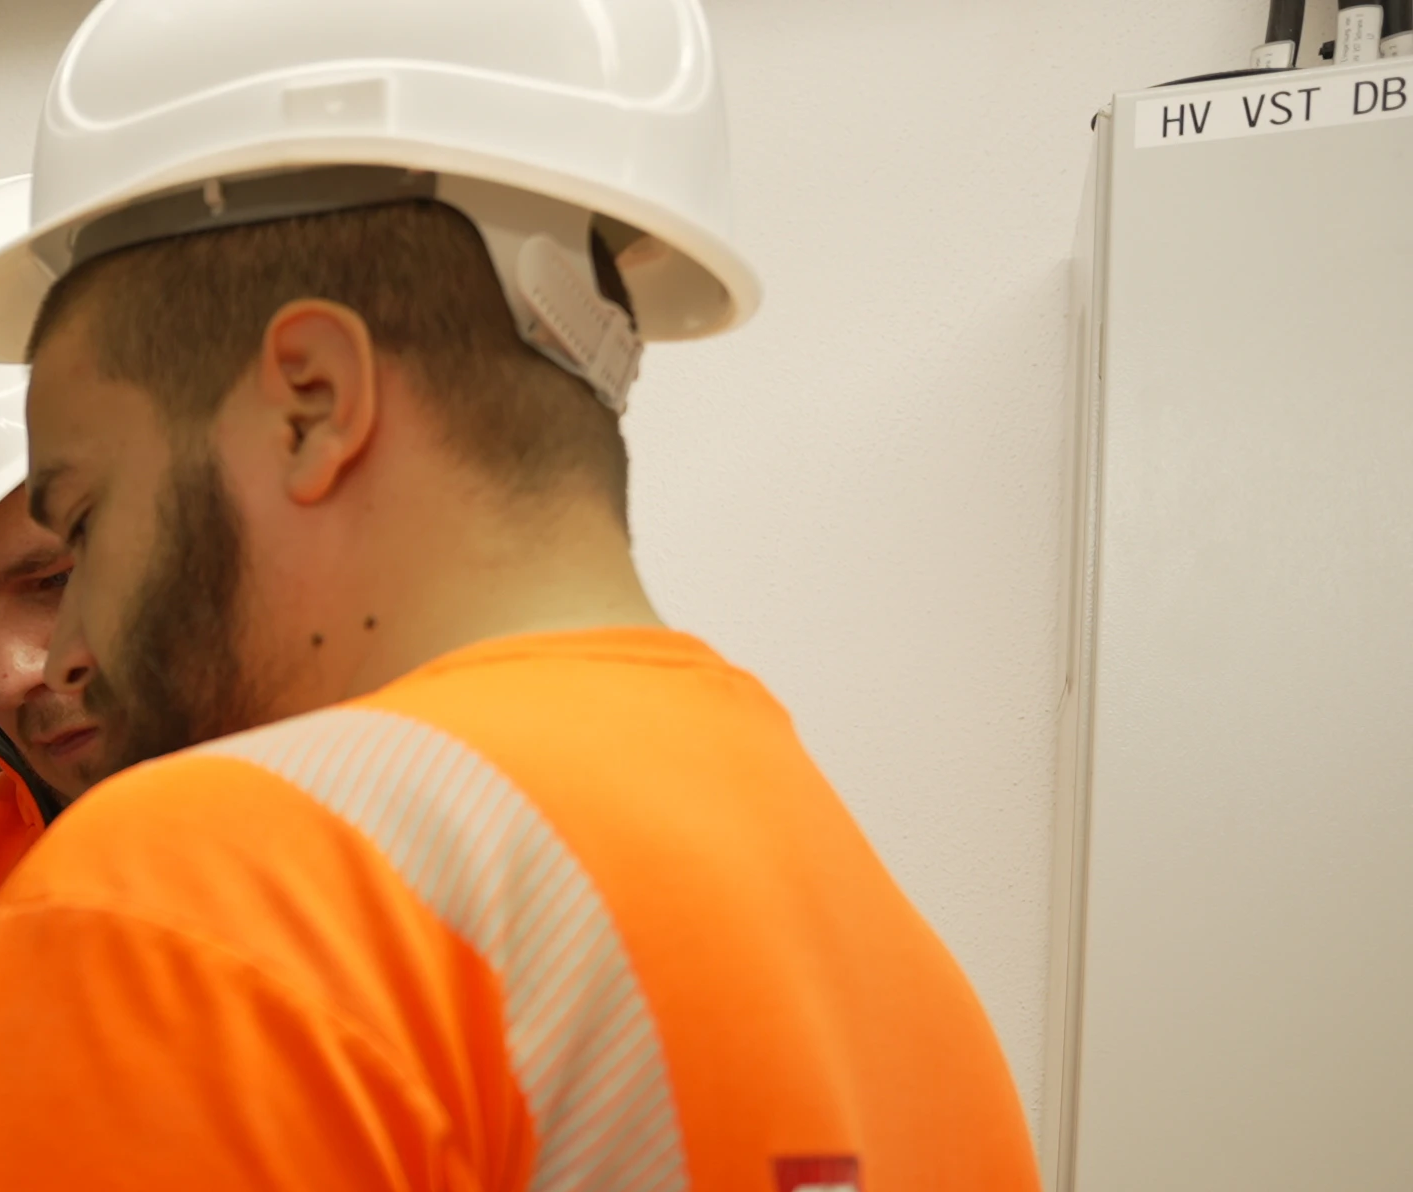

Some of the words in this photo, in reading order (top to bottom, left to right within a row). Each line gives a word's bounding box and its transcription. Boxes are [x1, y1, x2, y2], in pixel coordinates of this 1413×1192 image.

[1161, 100, 1212, 138] HV
[1242, 86, 1321, 128] VST
[1352, 76, 1408, 116] DB
